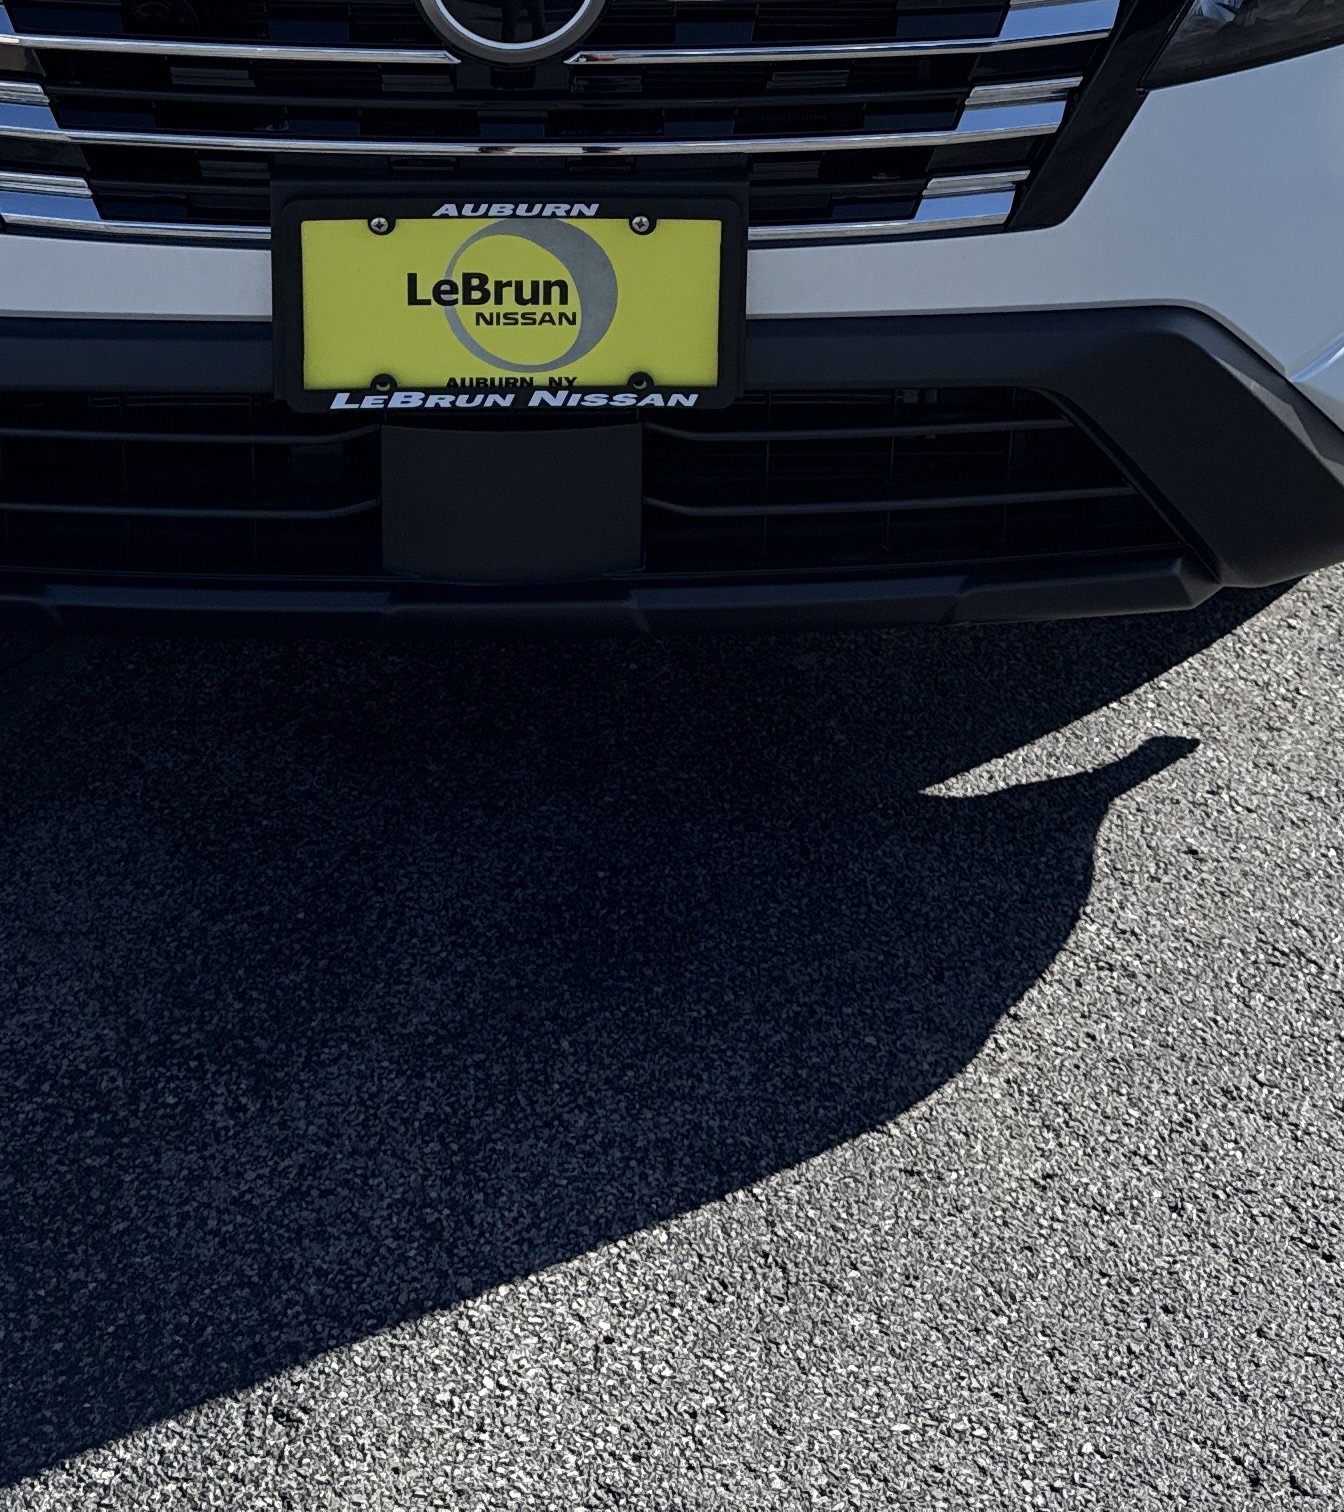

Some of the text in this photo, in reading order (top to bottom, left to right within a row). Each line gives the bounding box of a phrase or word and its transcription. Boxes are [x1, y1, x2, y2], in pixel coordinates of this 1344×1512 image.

[432, 203, 599, 217] AUBURN
[407, 273, 569, 306] LeBrun
[475, 312, 577, 326] NISSAN
[548, 376, 578, 387] NY
